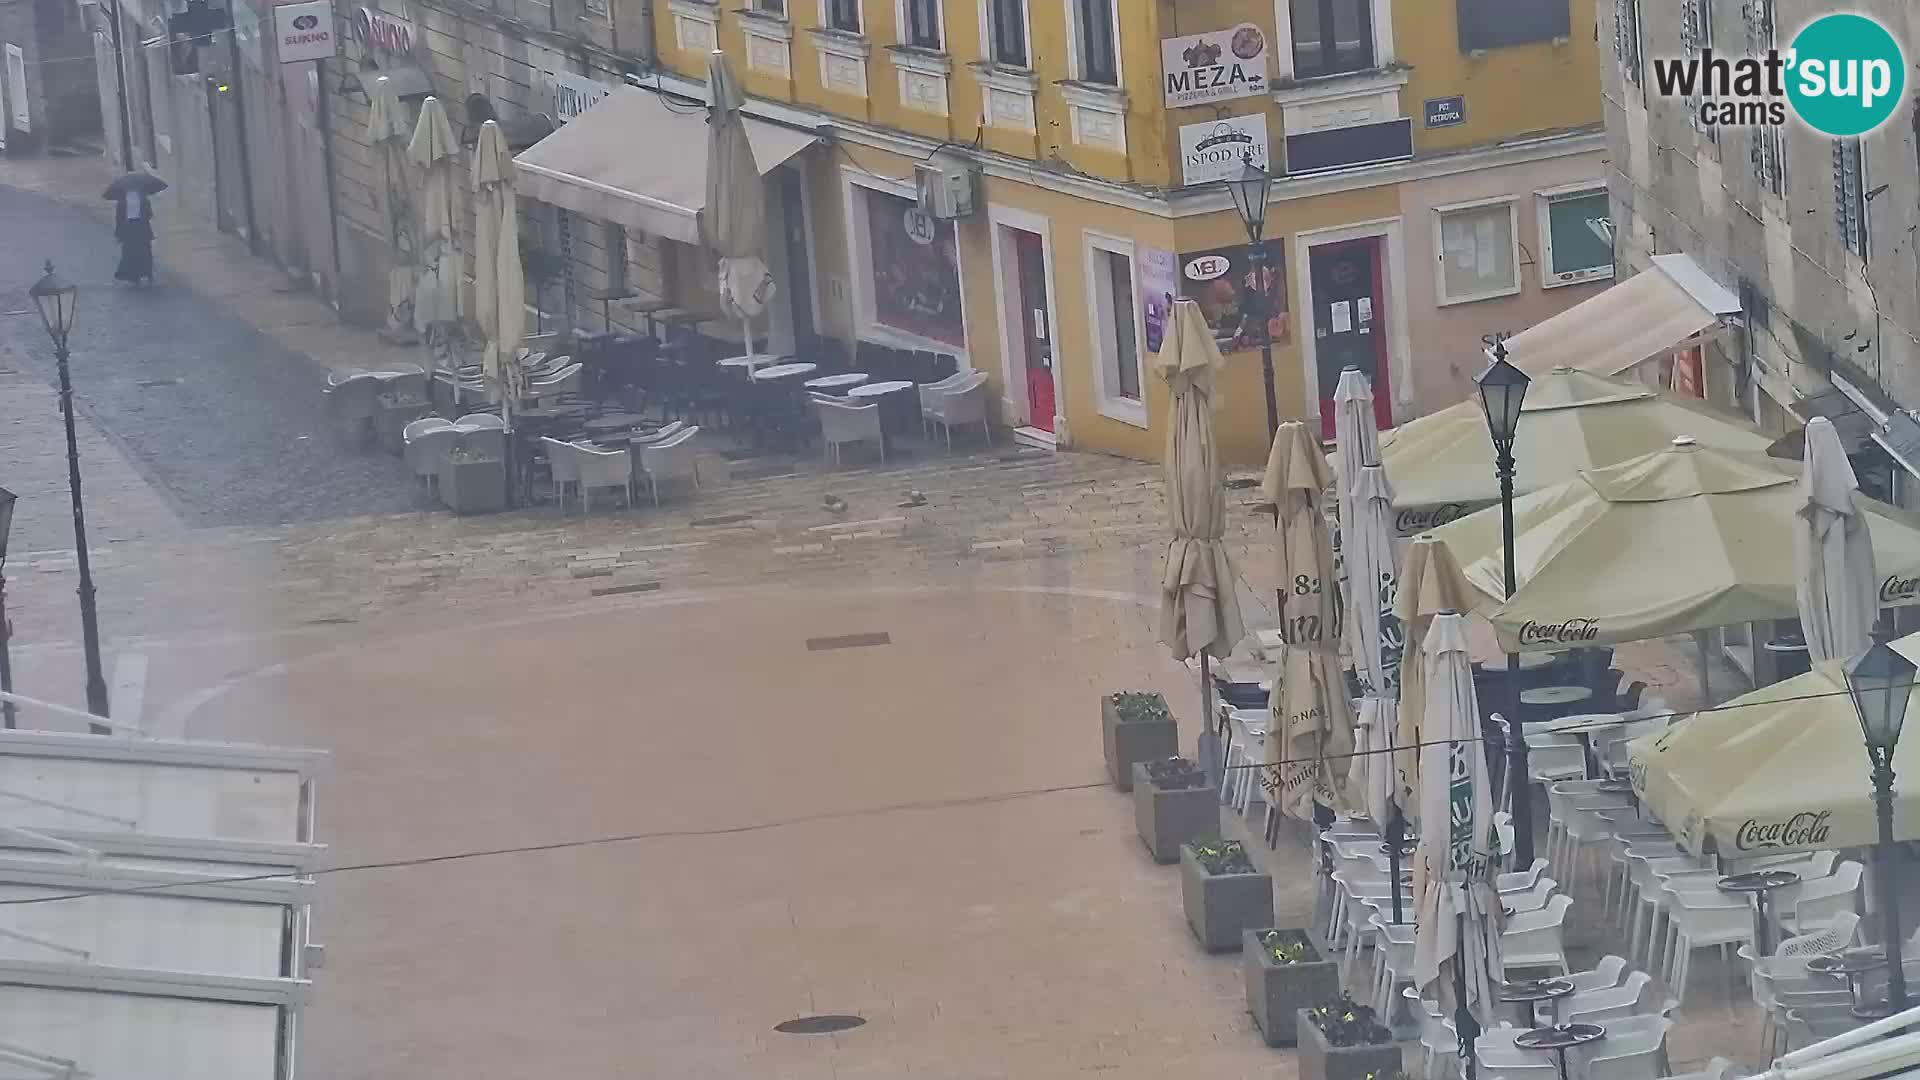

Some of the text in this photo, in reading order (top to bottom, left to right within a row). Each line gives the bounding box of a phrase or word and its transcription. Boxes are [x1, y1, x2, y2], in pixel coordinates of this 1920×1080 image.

[284, 32, 329, 45] SUKNO
[1167, 63, 1249, 94] MEZA
[1186, 144, 1265, 168] ISPOD URE
[1519, 618, 1600, 645] Coca-Cola
[1736, 809, 1832, 850] Coca-Cola
